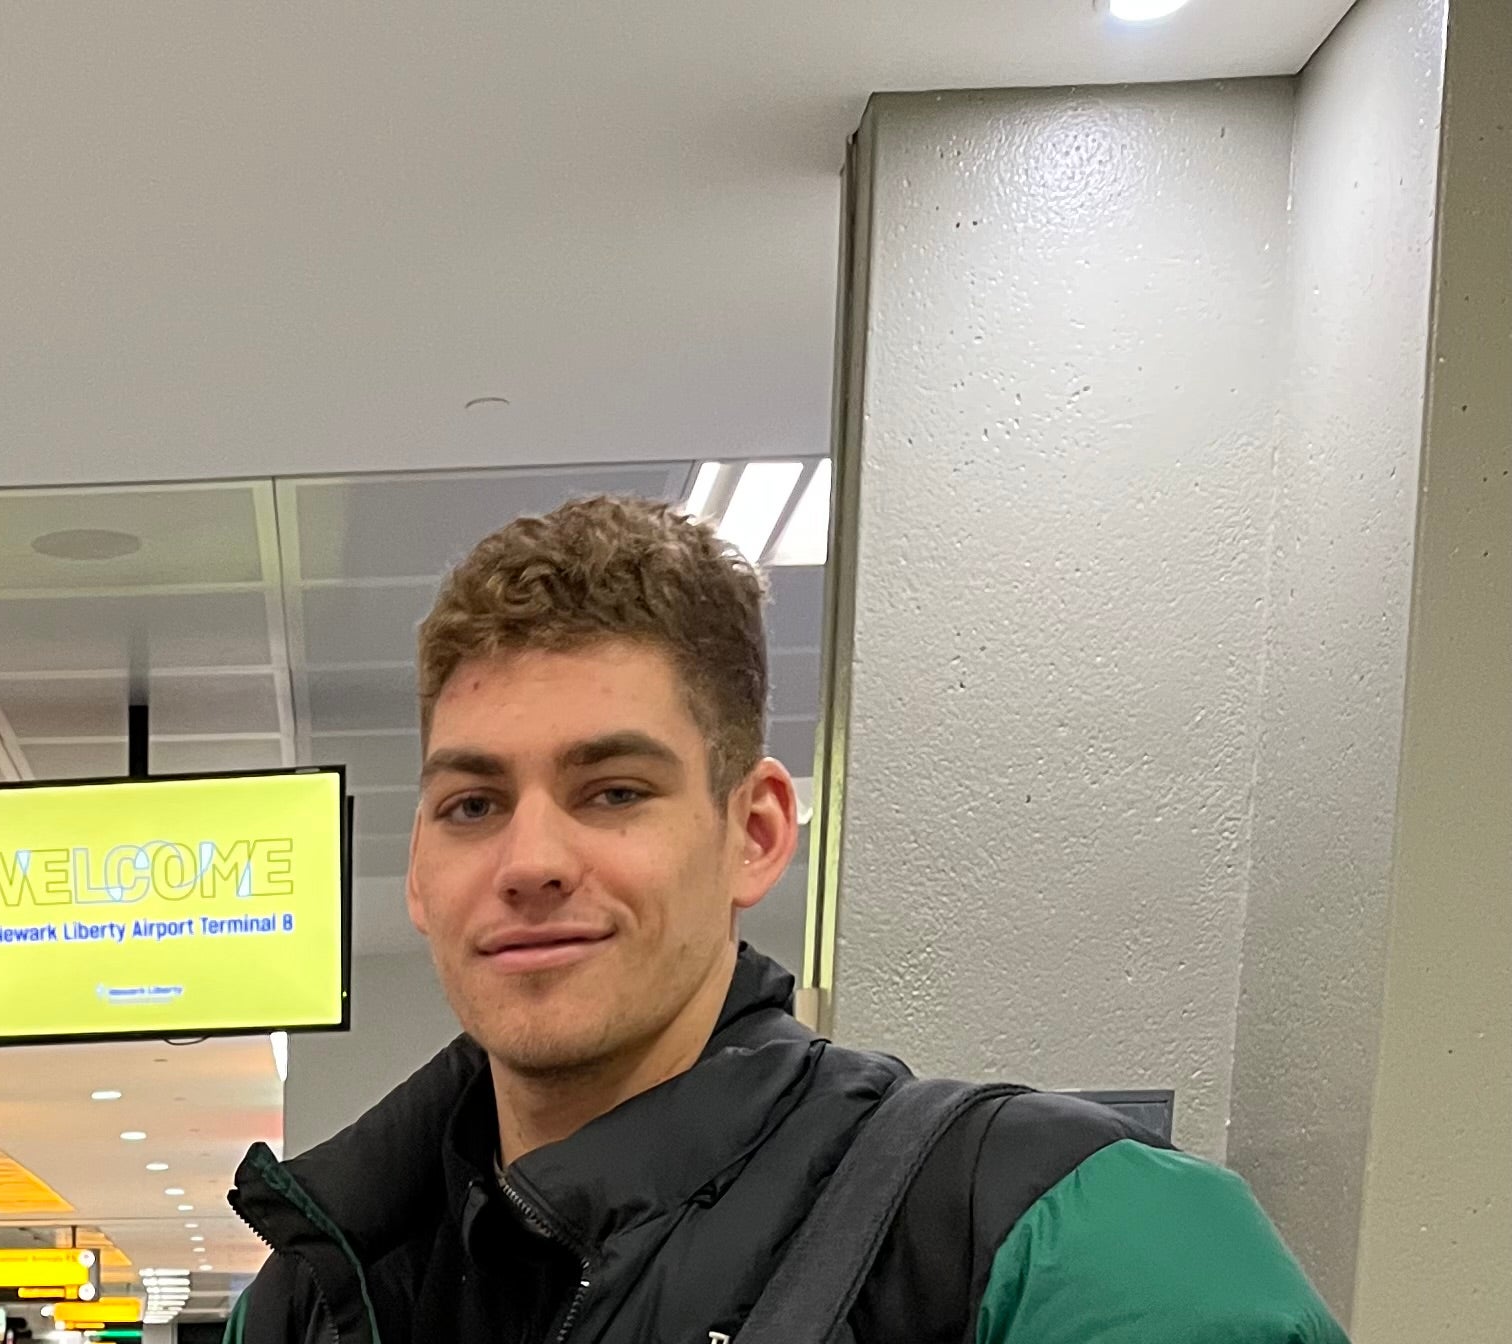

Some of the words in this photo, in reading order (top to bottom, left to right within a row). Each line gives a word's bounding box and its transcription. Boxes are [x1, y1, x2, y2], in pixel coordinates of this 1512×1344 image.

[64, 921, 125, 943] Liberty
[133, 918, 194, 941] Airport
[200, 913, 276, 935] Terminal
